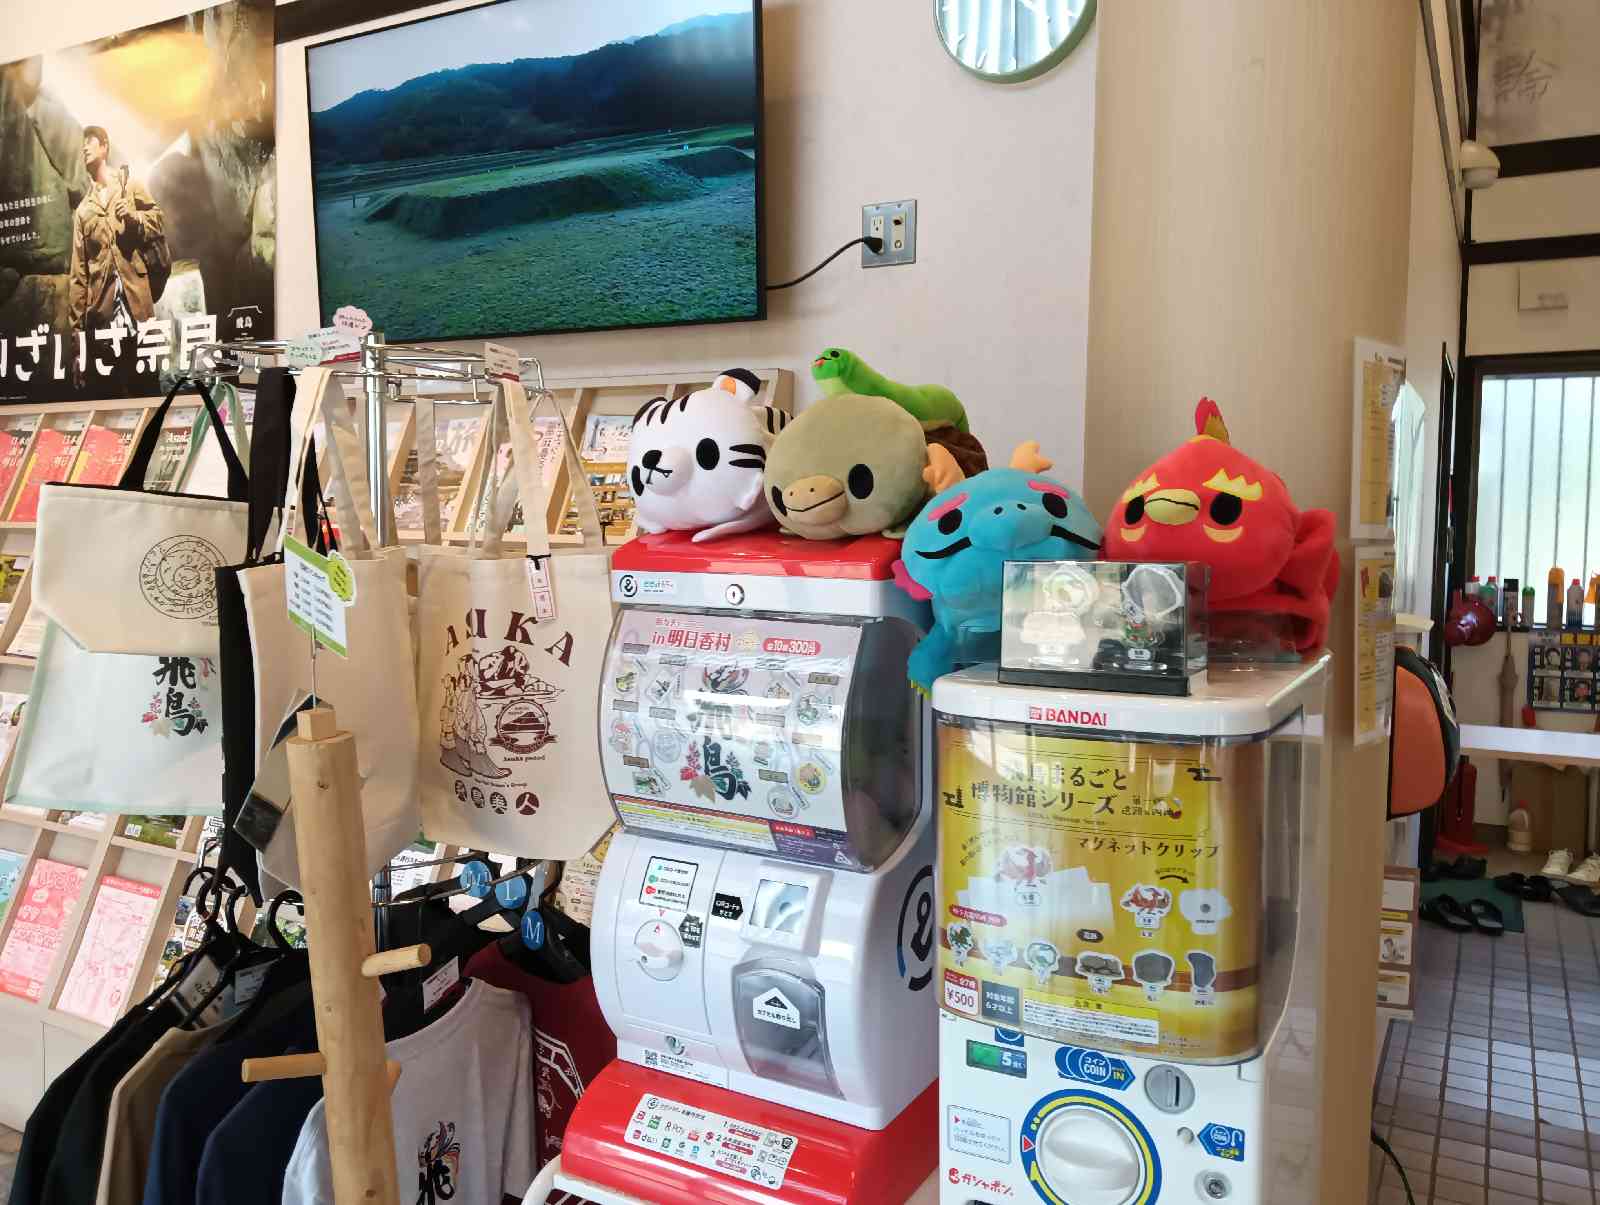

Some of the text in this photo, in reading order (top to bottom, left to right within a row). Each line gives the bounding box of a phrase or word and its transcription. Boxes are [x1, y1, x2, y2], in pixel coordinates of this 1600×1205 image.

[1046, 707, 1107, 726] BANDAI
[523, 917, 542, 944] M
[946, 988, 975, 1008] ¥500
[1001, 1051, 1012, 1067] 5
[1083, 1063, 1125, 1081] COIN IN
